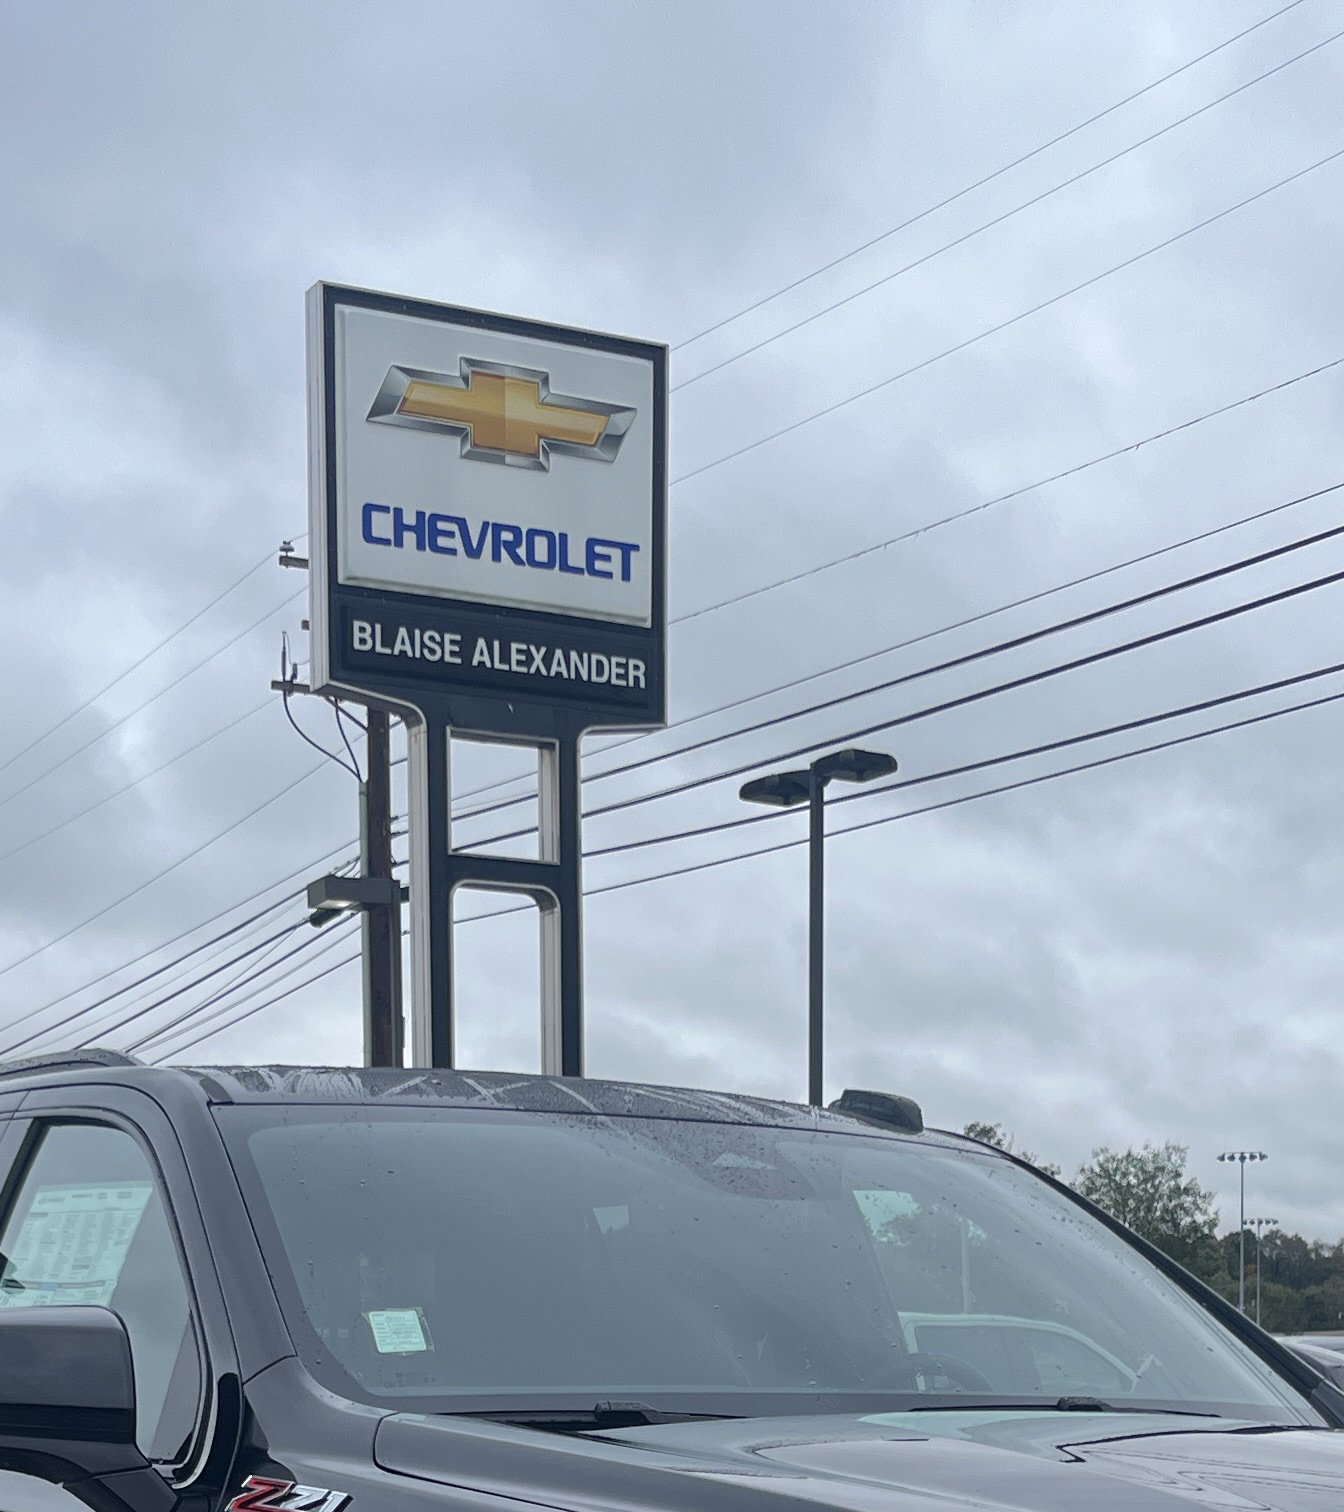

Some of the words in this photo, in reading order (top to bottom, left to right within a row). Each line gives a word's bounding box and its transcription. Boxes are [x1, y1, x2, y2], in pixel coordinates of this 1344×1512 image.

[361, 502, 640, 583] CHEVROLET
[352, 619, 462, 665] BLAISE
[472, 638, 646, 690] ALEXANDER
